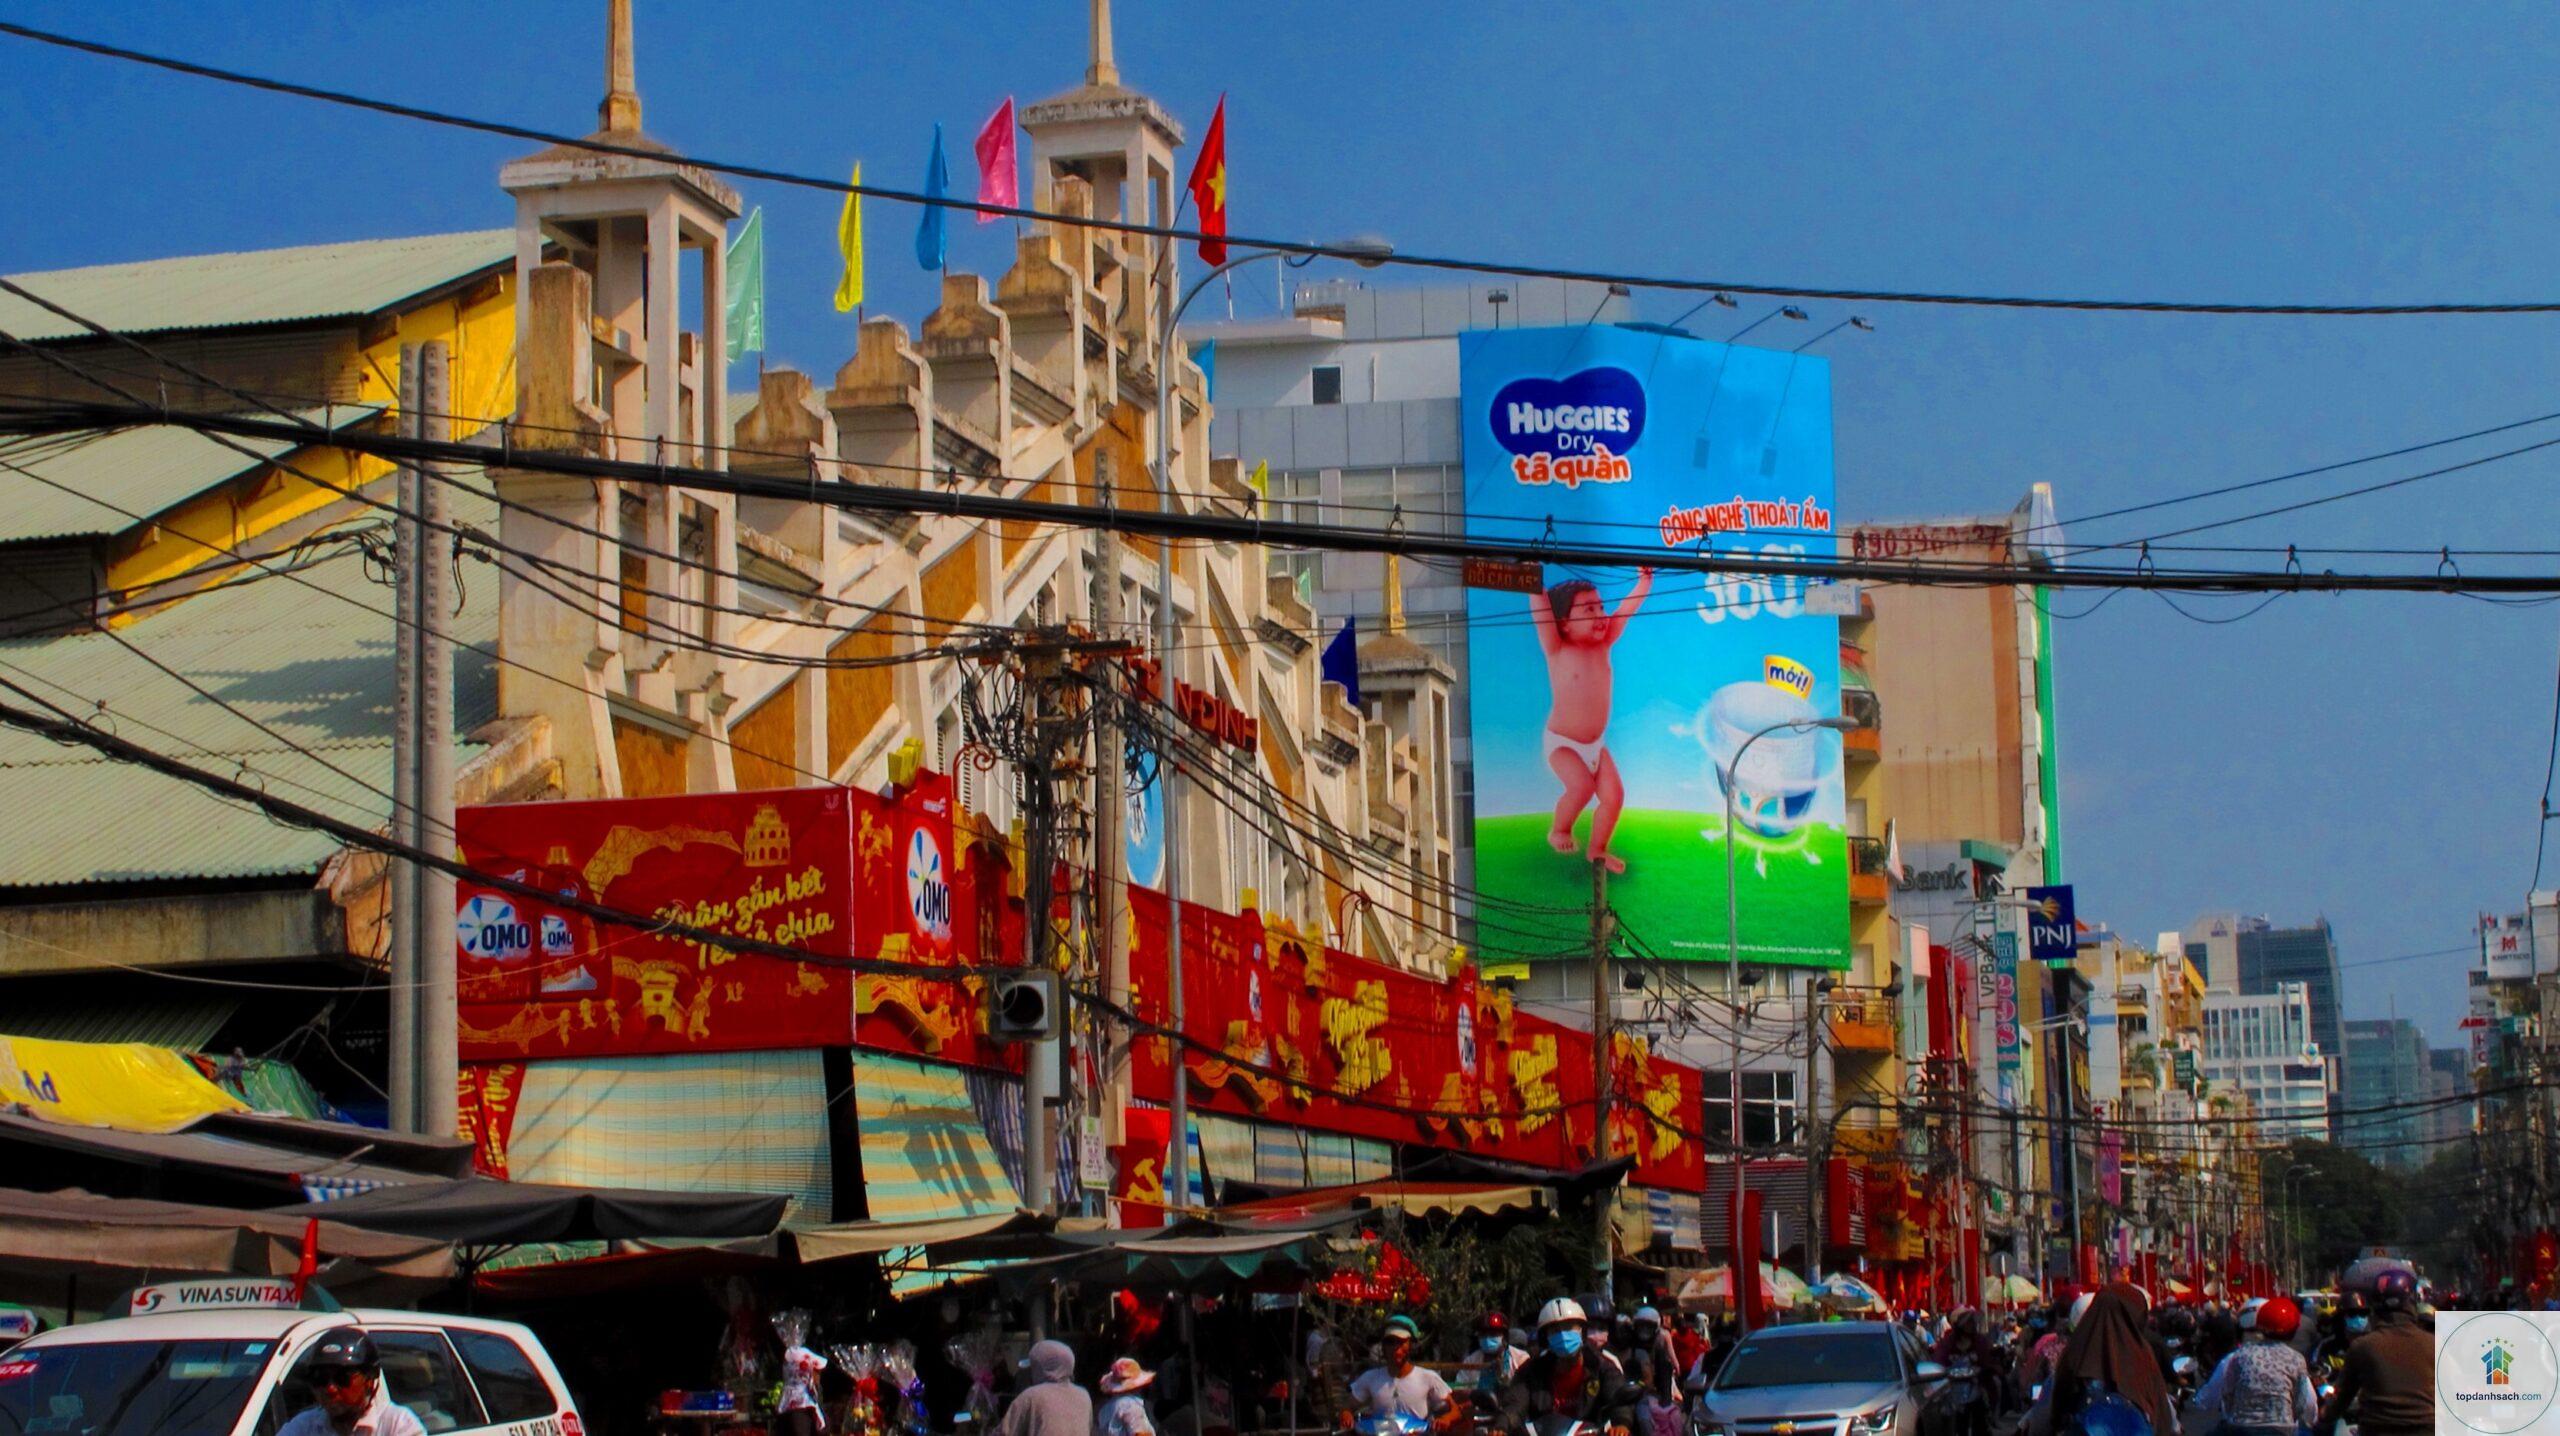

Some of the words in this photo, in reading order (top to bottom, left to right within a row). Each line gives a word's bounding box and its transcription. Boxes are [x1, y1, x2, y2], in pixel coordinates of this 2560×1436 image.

[1508, 402, 1631, 434] HUGGIES
[1557, 433, 1594, 452] Dry
[1514, 454, 1550, 482] tã
[1553, 444, 1630, 487] quần
[1660, 506, 1703, 546] CÔNG
[1769, 663, 1809, 692] mới!
[923, 879, 950, 925] OMO
[481, 924, 530, 951] OMO
[2032, 924, 2072, 949] PNJ
